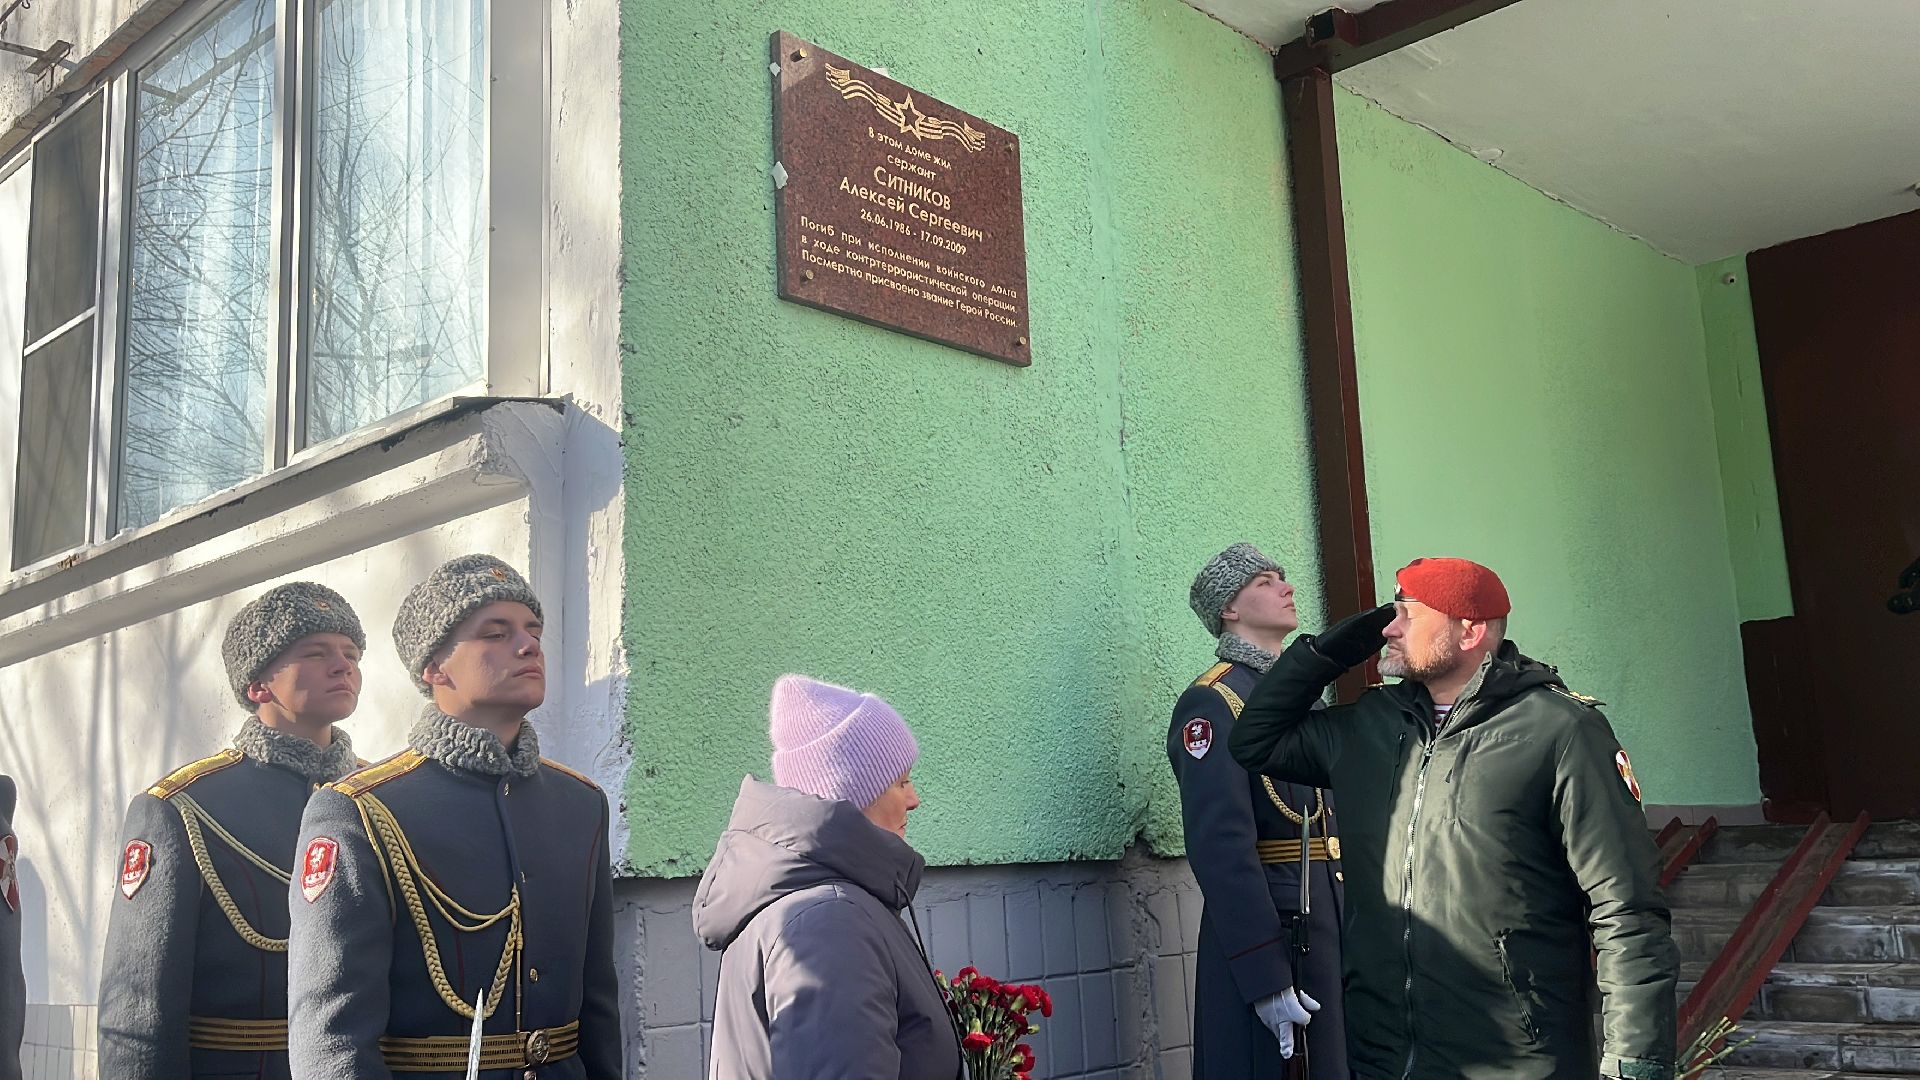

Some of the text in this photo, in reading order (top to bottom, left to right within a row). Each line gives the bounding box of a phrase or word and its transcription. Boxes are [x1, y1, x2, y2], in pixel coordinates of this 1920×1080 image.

[877, 132, 903, 150] этом
[905, 144, 931, 161] доме
[933, 155, 952, 170] жил
[887, 154, 937, 180] сержант
[839, 176, 983, 243] Алексей Сергеевич
[860, 208, 911, 236] 26.06.1986
[920, 230, 967, 255] 17.09.2009
[801, 215, 834, 237] Погиб
[841, 232, 861, 246] при
[868, 241, 930, 269] исполнении
[991, 284, 1017, 298] долга
[801, 235, 1018, 313] в ходе контртеррористической операции.
[802, 249, 1018, 328] Посмертно присвоено звание Герой России.
